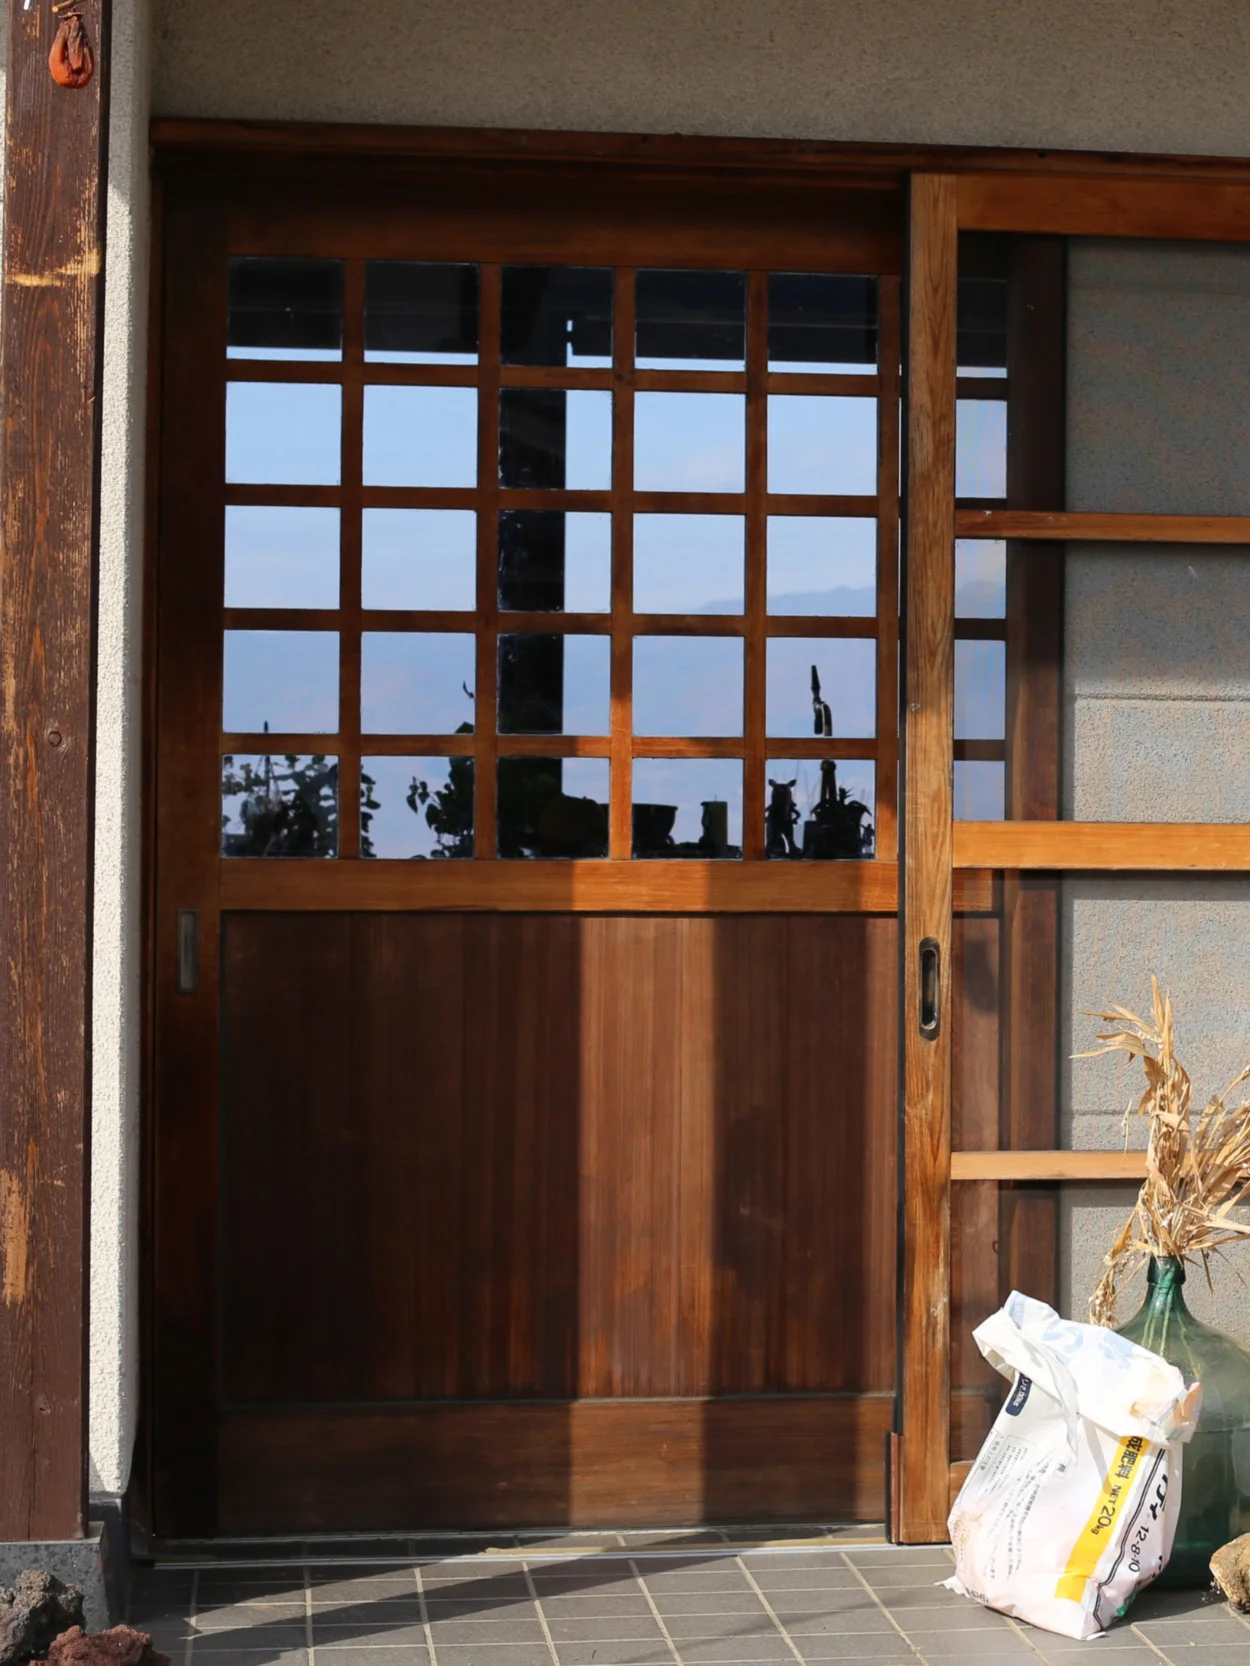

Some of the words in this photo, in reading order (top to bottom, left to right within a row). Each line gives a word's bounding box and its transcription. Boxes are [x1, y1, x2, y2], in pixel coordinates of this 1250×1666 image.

[1108, 1484, 1122, 1505] NET
[1090, 1504, 1117, 1535] 20kg
[1128, 1525, 1150, 1573] 12-8-10
